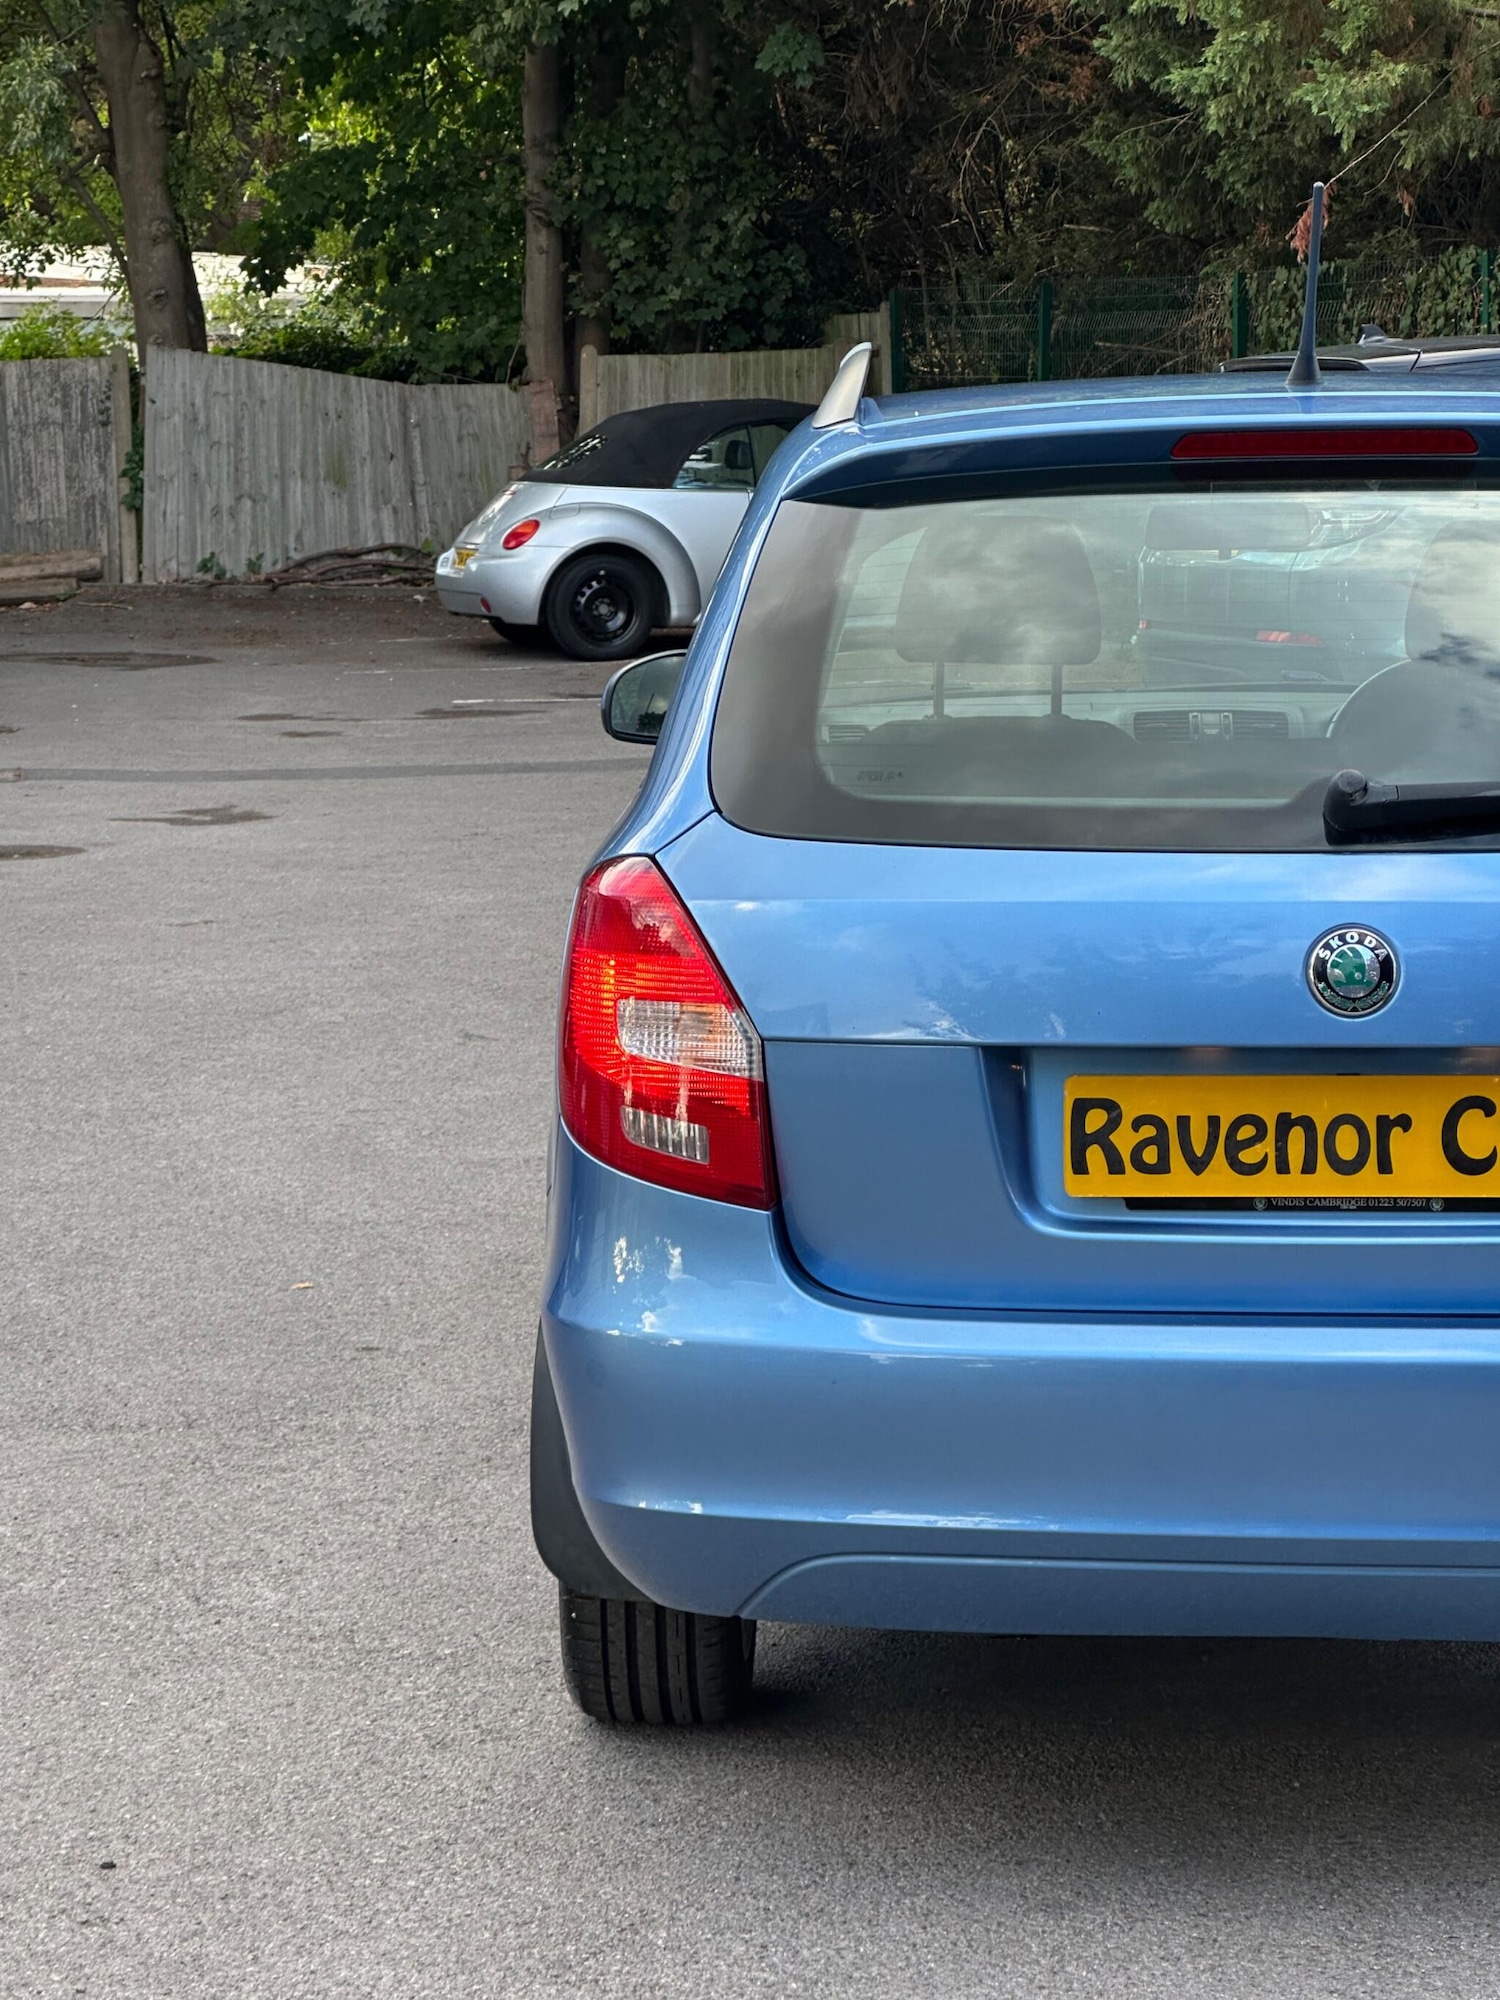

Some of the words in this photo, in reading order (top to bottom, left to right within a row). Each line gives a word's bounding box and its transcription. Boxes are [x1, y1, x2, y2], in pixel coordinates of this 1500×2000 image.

[1069, 1097, 1412, 1177] Ravenor
[1441, 1095, 1498, 1176] C
[1270, 1197, 1305, 1207] VINDIS
[1306, 1197, 1368, 1207] CAMBRIDGE
[1368, 1197, 1395, 1207] 01223
[1396, 1197, 1427, 1207] 507507
